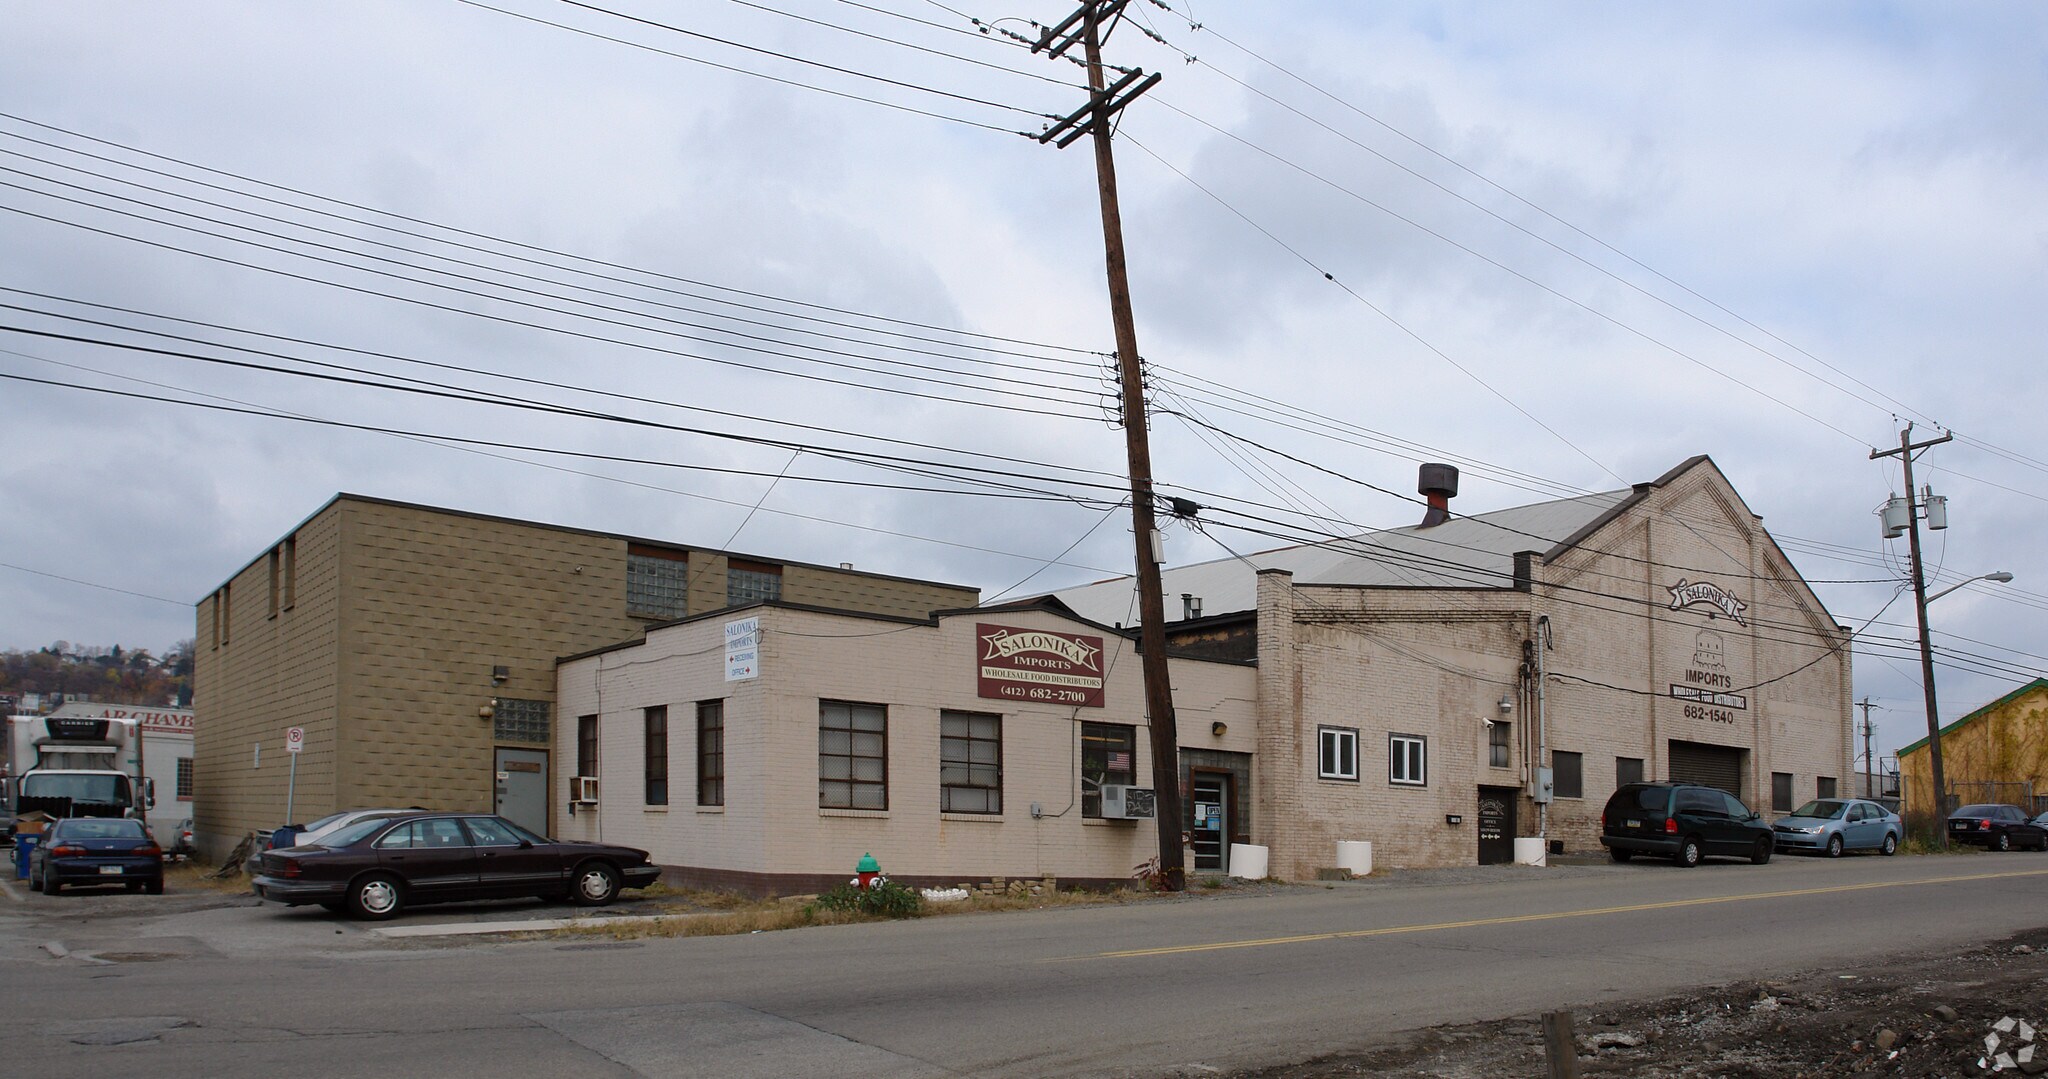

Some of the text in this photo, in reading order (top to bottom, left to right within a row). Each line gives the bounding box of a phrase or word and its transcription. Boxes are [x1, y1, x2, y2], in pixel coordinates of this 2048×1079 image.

[1686, 586, 1729, 610] SALONIKA
[727, 621, 756, 636] SALONIKA
[731, 637, 752, 649] IMPORTS
[1000, 635, 1080, 662] SALONIKA
[734, 652, 754, 661] RECEIVING
[1014, 656, 1071, 669] IMPORTS
[732, 667, 745, 676] OFFICE
[985, 669, 1101, 686] WHOLESALE FOOD DISTRIBUTORS
[1685, 669, 1731, 688] IMPORTS
[1000, 685, 1085, 702] (412) 682-2700
[1684, 705, 1733, 724] 682-1540
